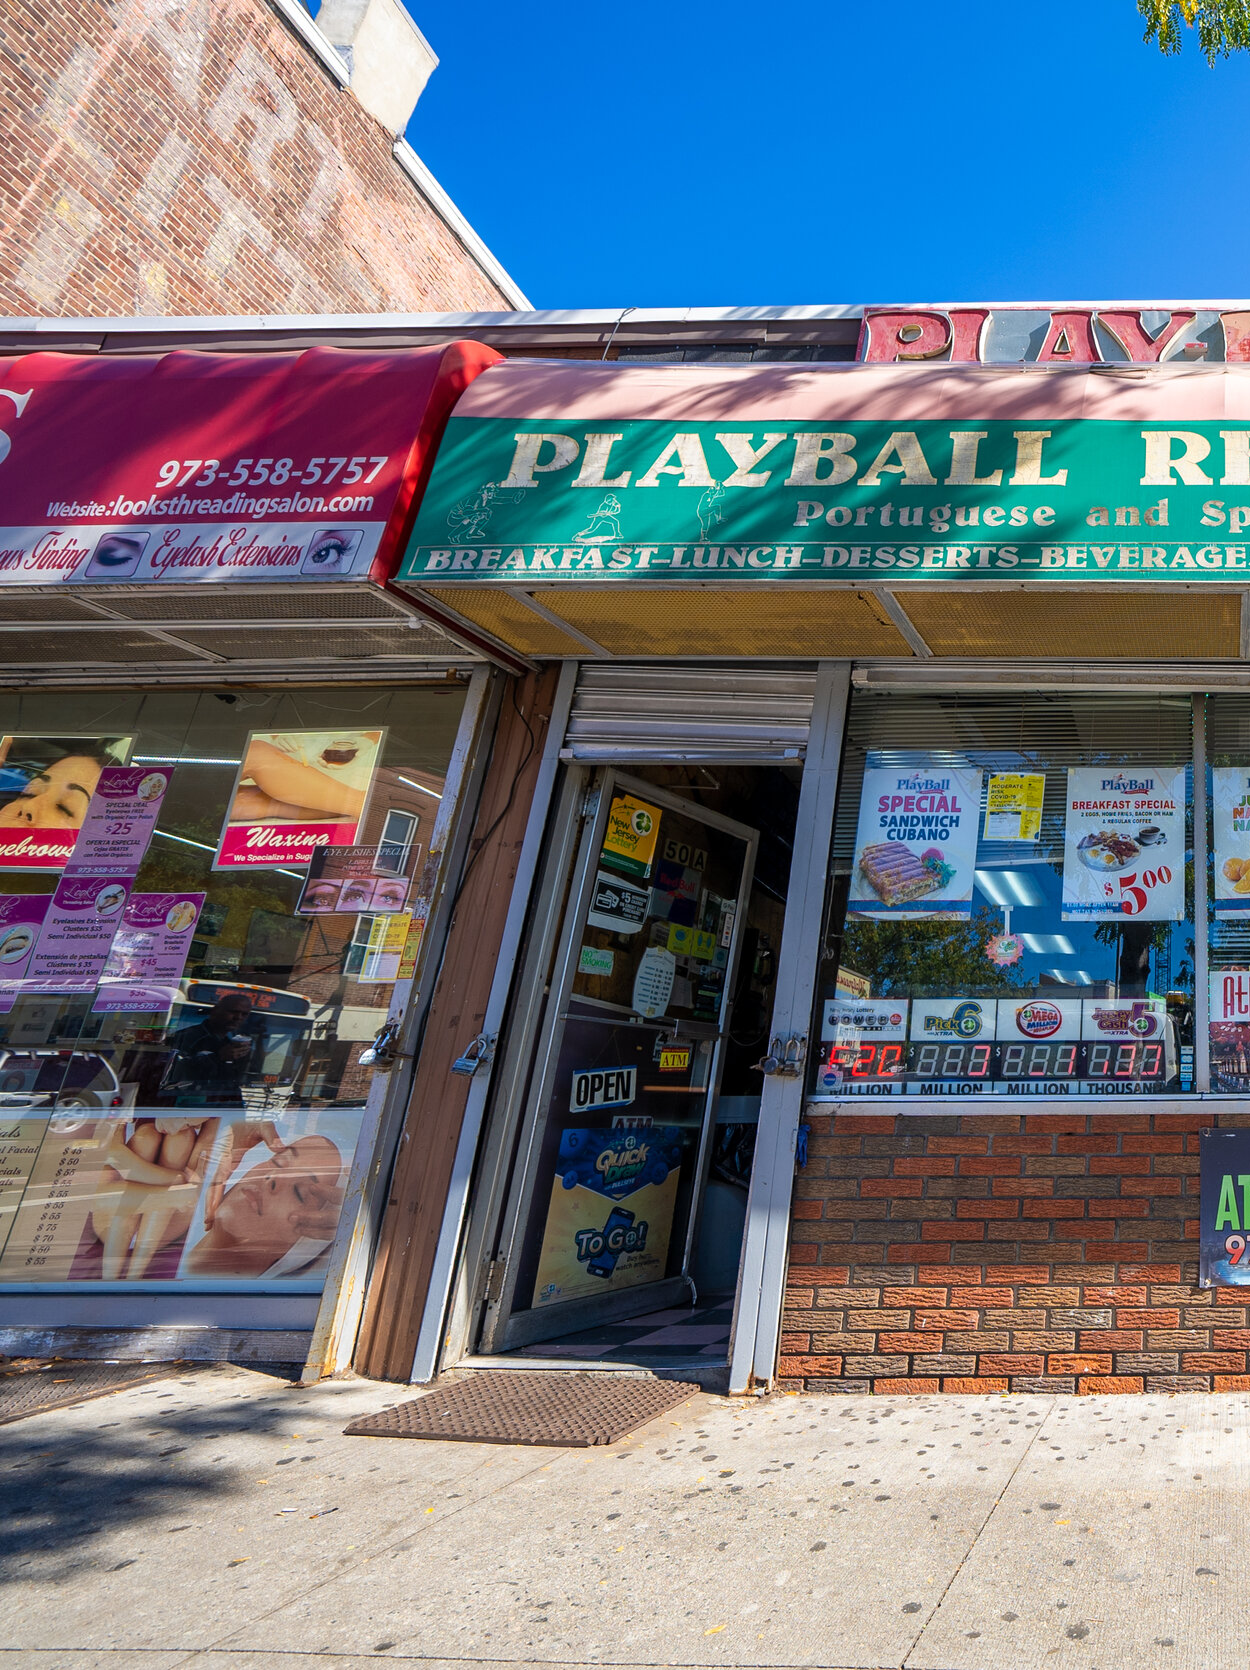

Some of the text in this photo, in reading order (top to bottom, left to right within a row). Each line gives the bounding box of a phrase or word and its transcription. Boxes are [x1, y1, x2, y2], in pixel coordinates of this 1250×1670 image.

[501, 430, 1069, 489] PLAYBALL
[155, 456, 389, 489] 973-558-5757
[794, 500, 1057, 535] Portuguese
[1087, 500, 1170, 529] and
[24, 530, 91, 581] Tinting
[150, 528, 220, 580] Eyelash
[218, 527, 305, 569] Extensions
[896, 778, 950, 793] PlayBall
[1101, 779, 1155, 794] PlayBall
[877, 795, 962, 813] SPECIAL
[1072, 800, 1176, 810] BREAKFAST SPECIAL
[105, 823, 133, 835] $25
[610, 815, 631, 830] New
[879, 815, 960, 828] SANDWICH
[246, 827, 331, 848] Waxing
[612, 826, 640, 844] Jersey
[886, 828, 950, 841] CUBANO
[606, 832, 638, 853] Lottery
[246, 853, 285, 863] Specialize
[582, 949, 593, 958] NO
[581, 958, 612, 969] SMOKING
[923, 1001, 983, 1039] Pick 6
[1029, 1009, 1058, 1022] MEGA
[1091, 1007, 1132, 1021] Jersey
[1097, 1019, 1129, 1031] Cash
[662, 1052, 688, 1067] ATM
[576, 1070, 632, 1107] OPEN
[920, 1083, 983, 1095] MILLION
[1007, 1083, 1070, 1095] MILLION
